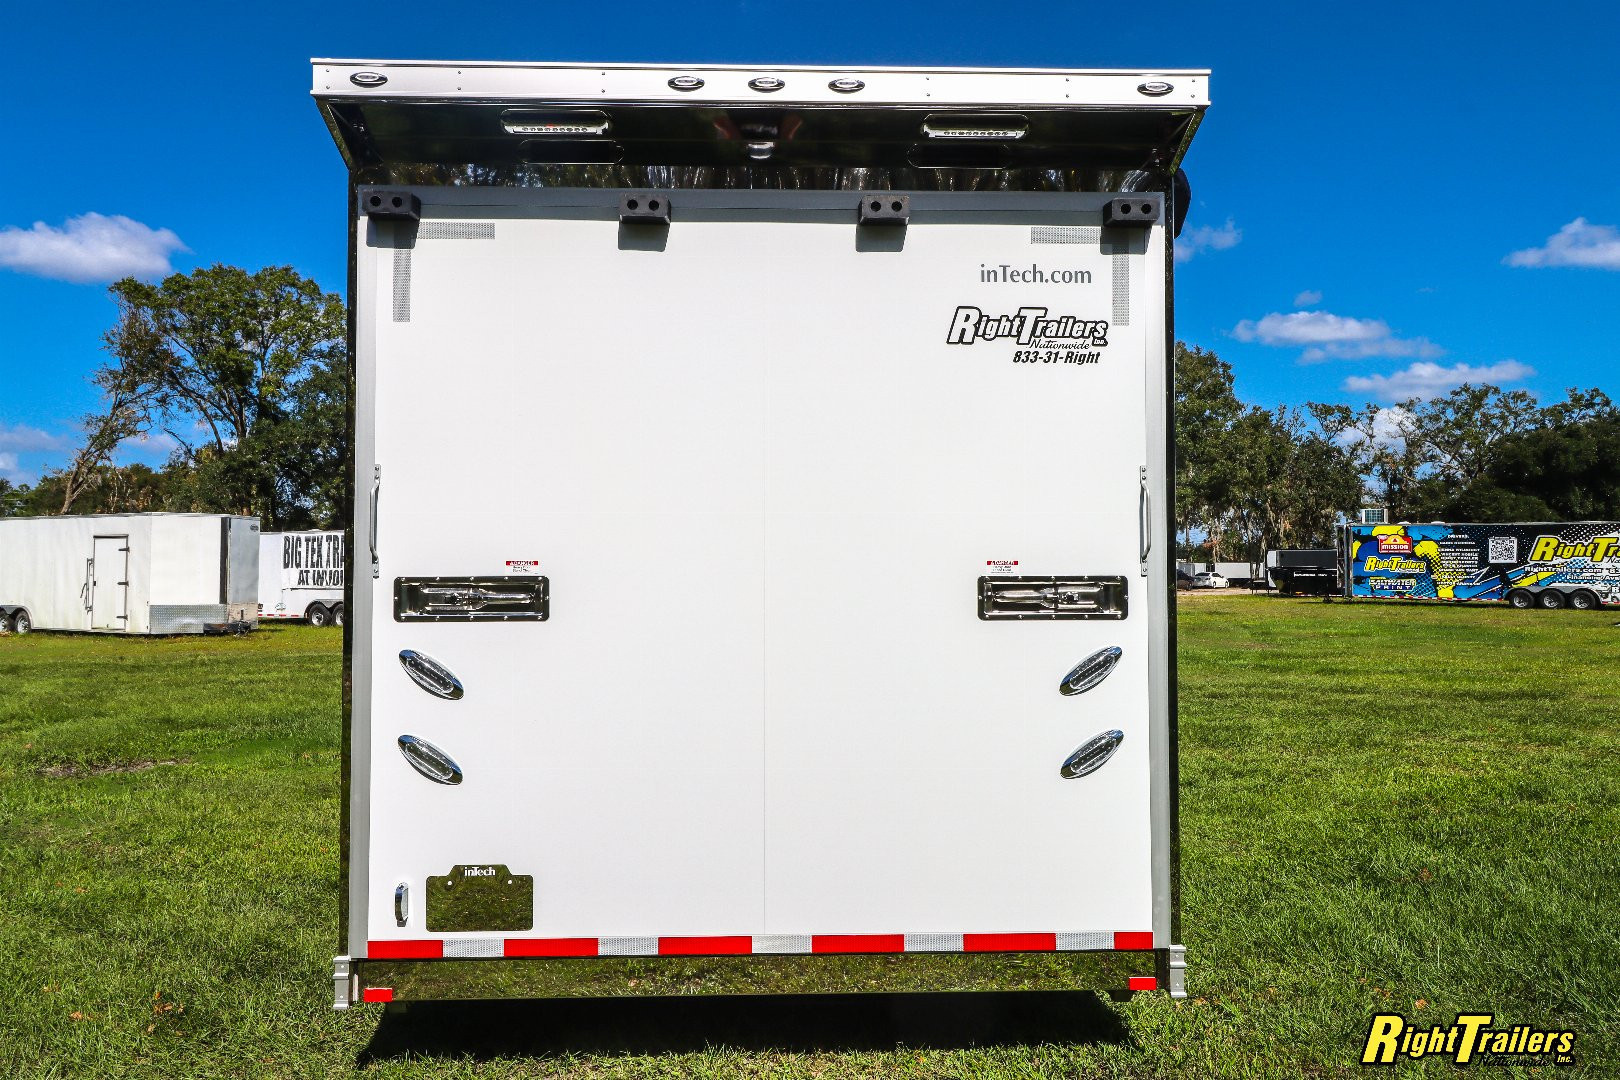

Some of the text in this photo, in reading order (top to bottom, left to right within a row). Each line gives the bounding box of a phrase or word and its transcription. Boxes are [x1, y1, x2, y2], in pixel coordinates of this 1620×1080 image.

[980, 263, 1092, 284] inTech.com
[946, 305, 1109, 345] RightTrailers
[1028, 338, 1091, 350] Nationwide
[1013, 350, 1101, 365] 833-31-Right
[283, 535, 302, 569] BIG
[304, 535, 324, 569] TEX
[297, 570, 310, 586] AT
[464, 866, 496, 877] inTech
